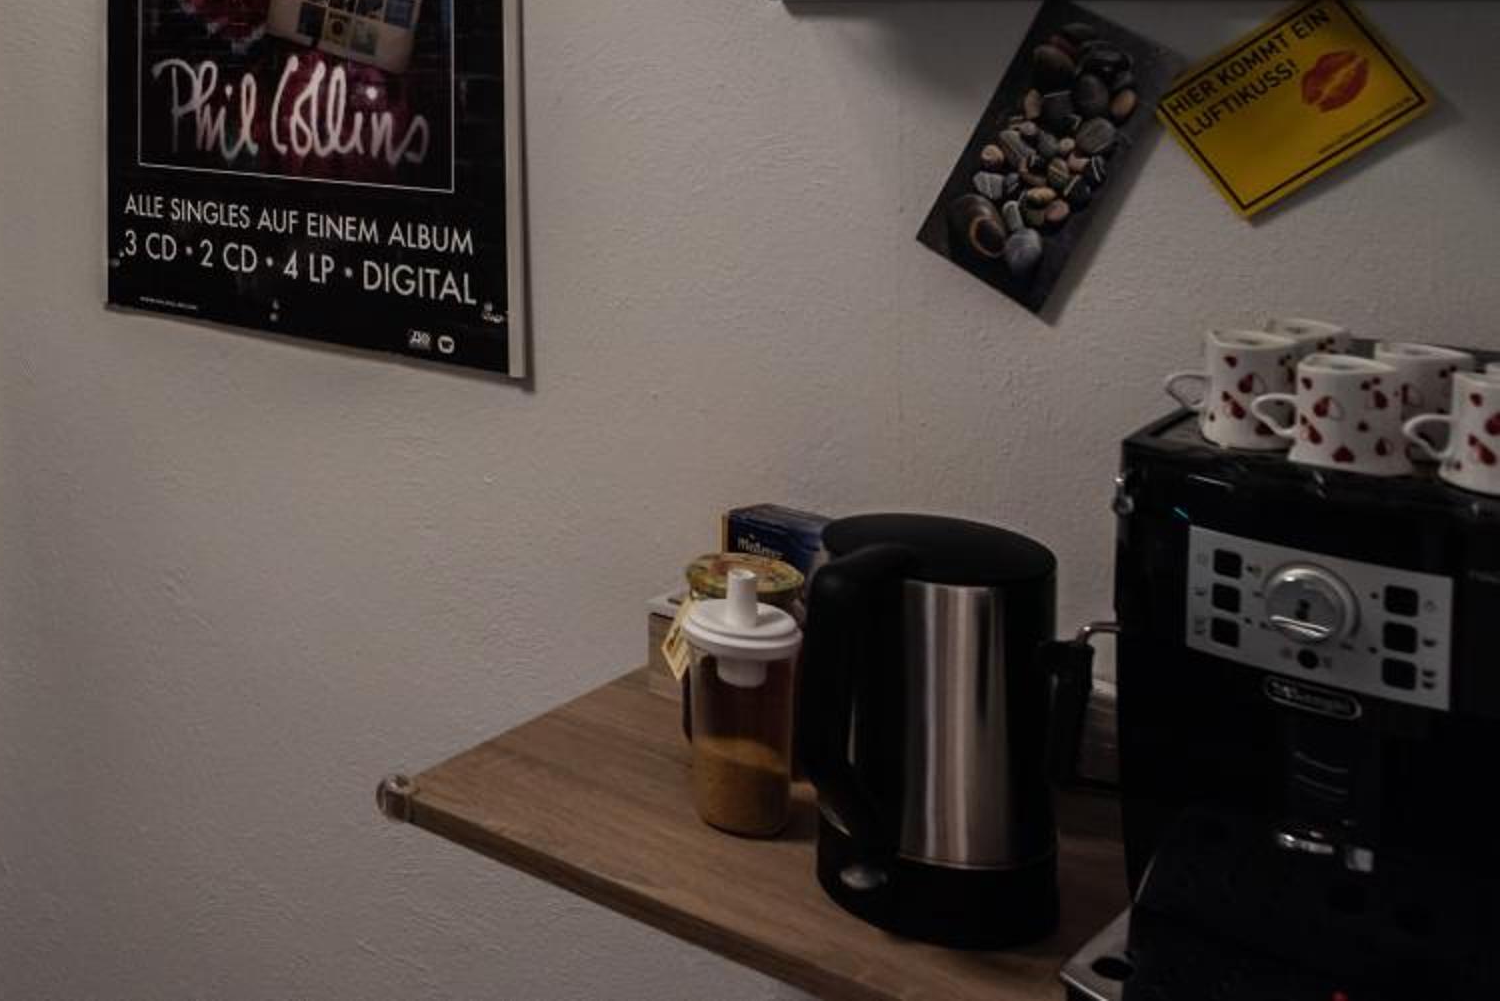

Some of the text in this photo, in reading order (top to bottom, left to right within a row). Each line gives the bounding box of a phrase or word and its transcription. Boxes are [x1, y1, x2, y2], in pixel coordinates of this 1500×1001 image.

[1167, 7, 1331, 116] HIER KOMMT EIN
[1183, 58, 1299, 137] LUFTIKUSS!
[152, 55, 430, 165] Phil Collins
[124, 193, 474, 256] ALLE SINGLES AUF EINEM ALBUM
[124, 230, 477, 306] 3 CD 2 CD 4 LP DIGITAL
